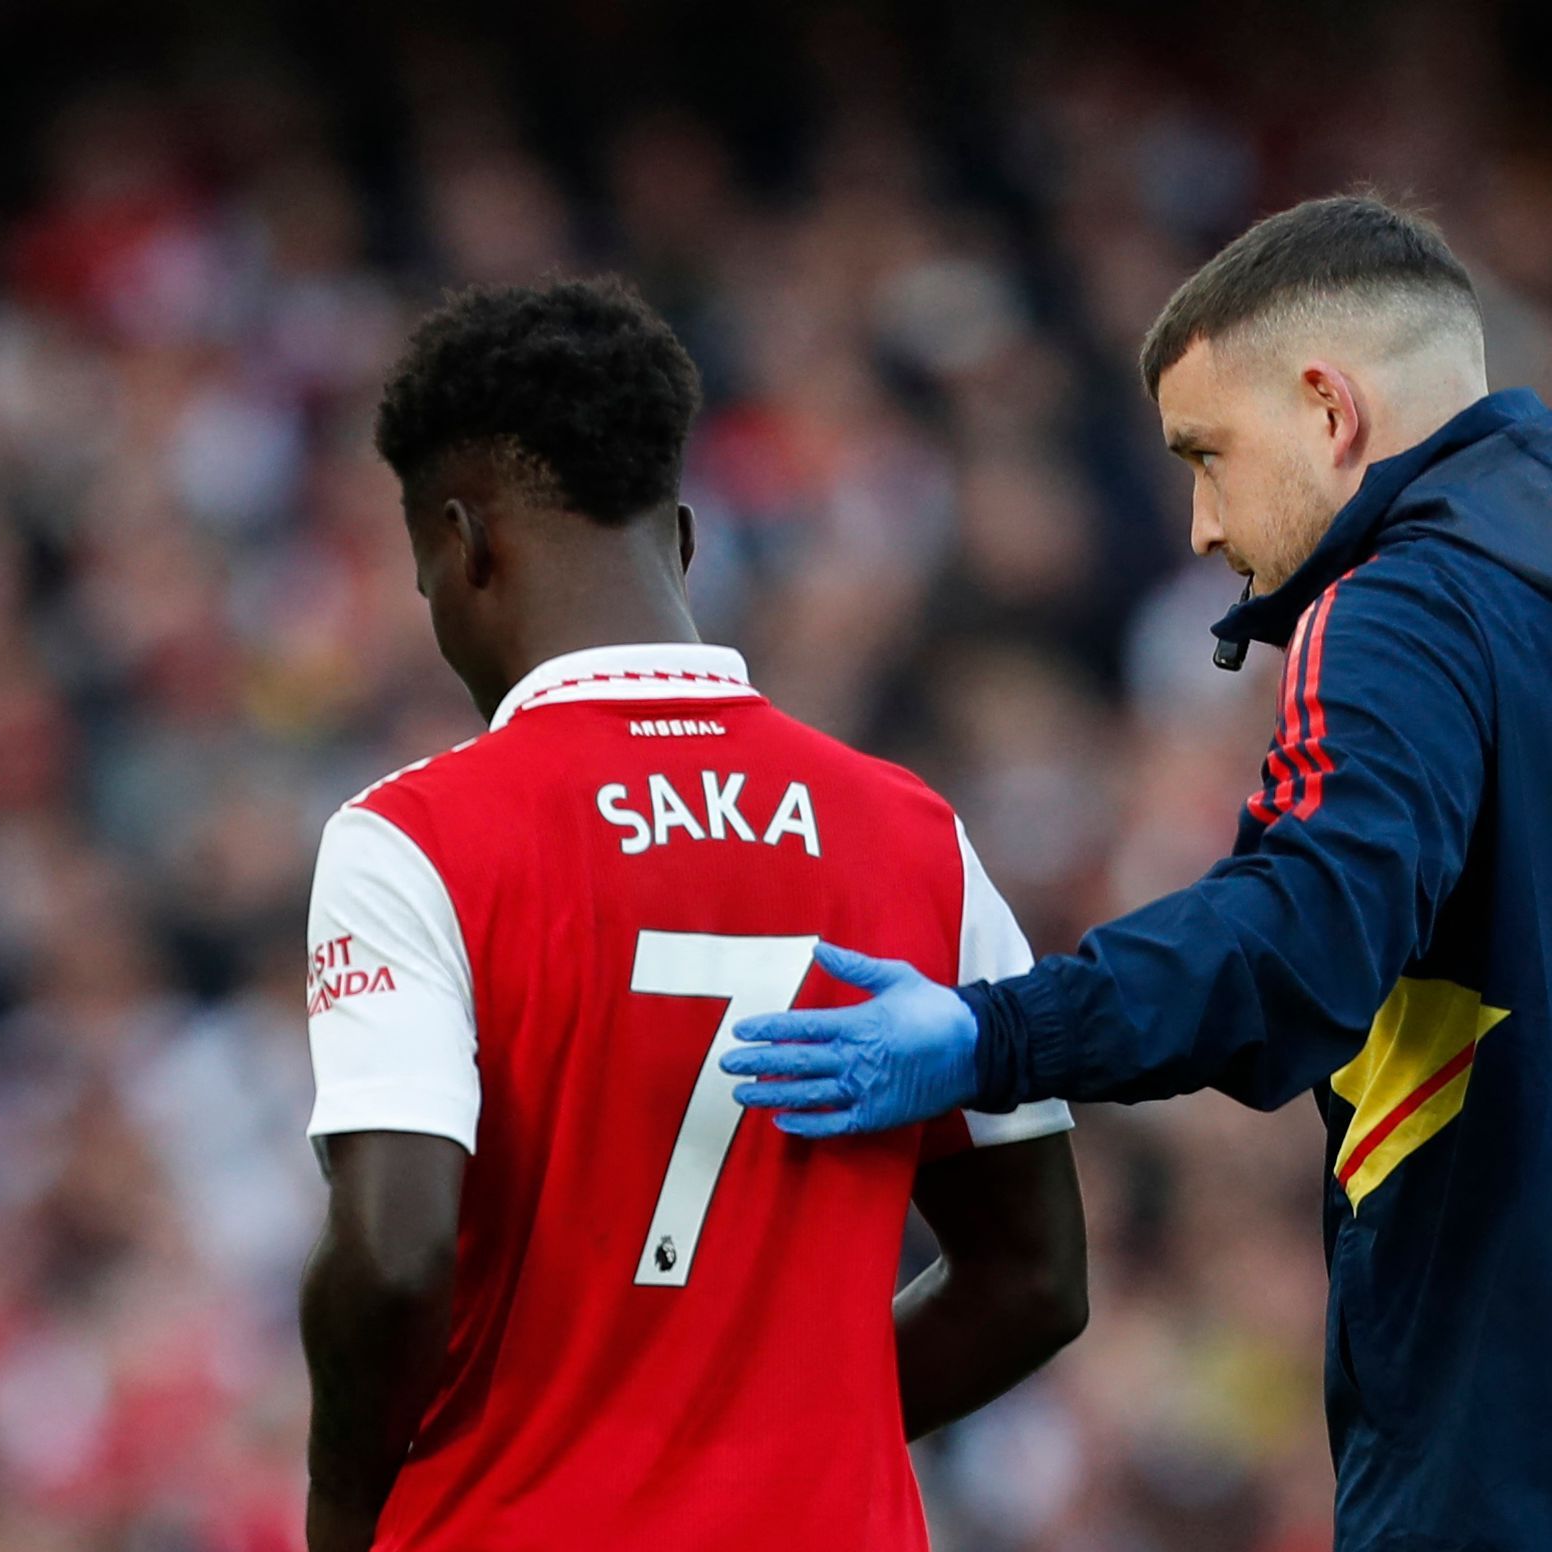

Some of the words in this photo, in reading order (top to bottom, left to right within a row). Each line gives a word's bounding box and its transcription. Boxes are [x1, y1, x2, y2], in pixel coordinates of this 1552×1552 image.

[629, 719, 727, 737] ARSENAL
[596, 770, 822, 858] SAKA
[308, 966, 396, 1018] ANDA
[630, 930, 820, 1287] 7
